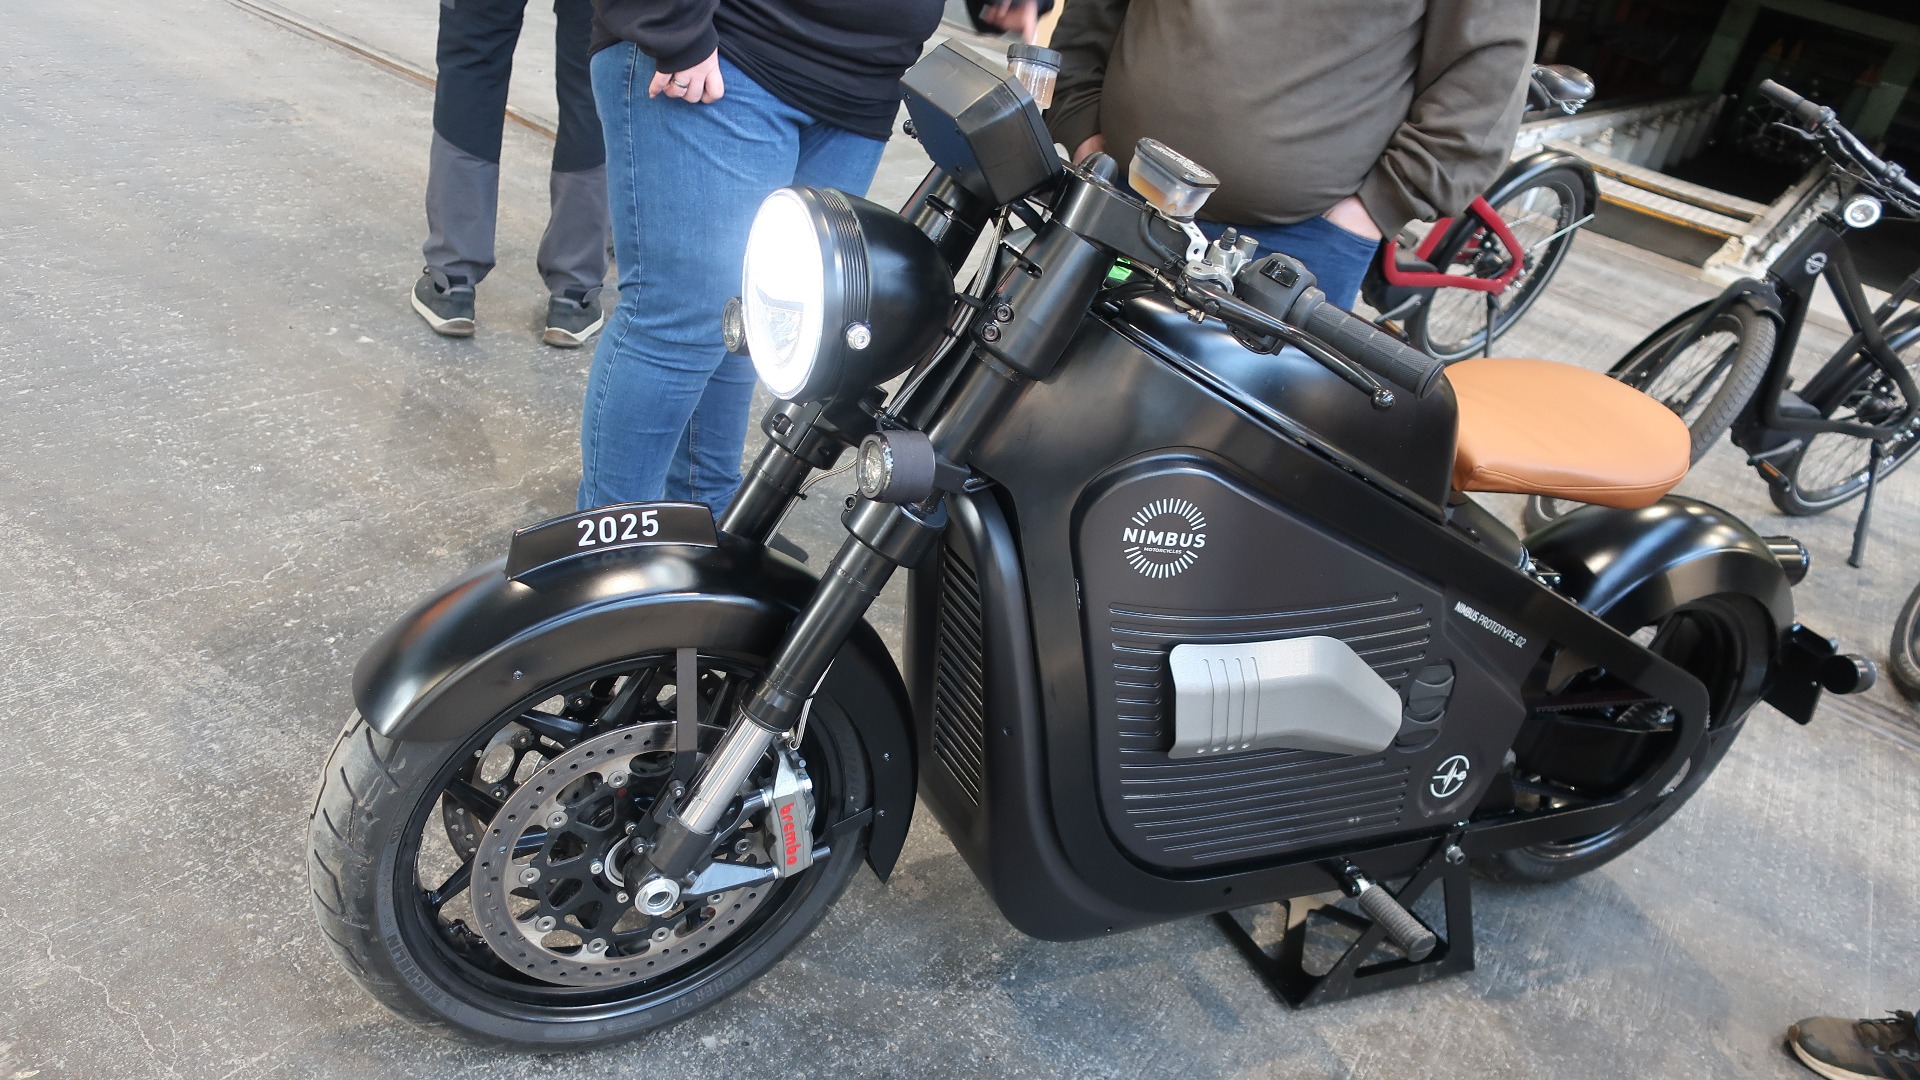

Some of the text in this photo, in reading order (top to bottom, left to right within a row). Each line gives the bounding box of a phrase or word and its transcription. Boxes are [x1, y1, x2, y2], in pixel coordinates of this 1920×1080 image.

[577, 510, 658, 546] 2025
[1123, 527, 1206, 548] NIMBUS
[1454, 601, 1527, 649] NIMBUS PROTOTYPE 02
[779, 802, 801, 866] brembo
[385, 933, 446, 1006] MICHELIN
